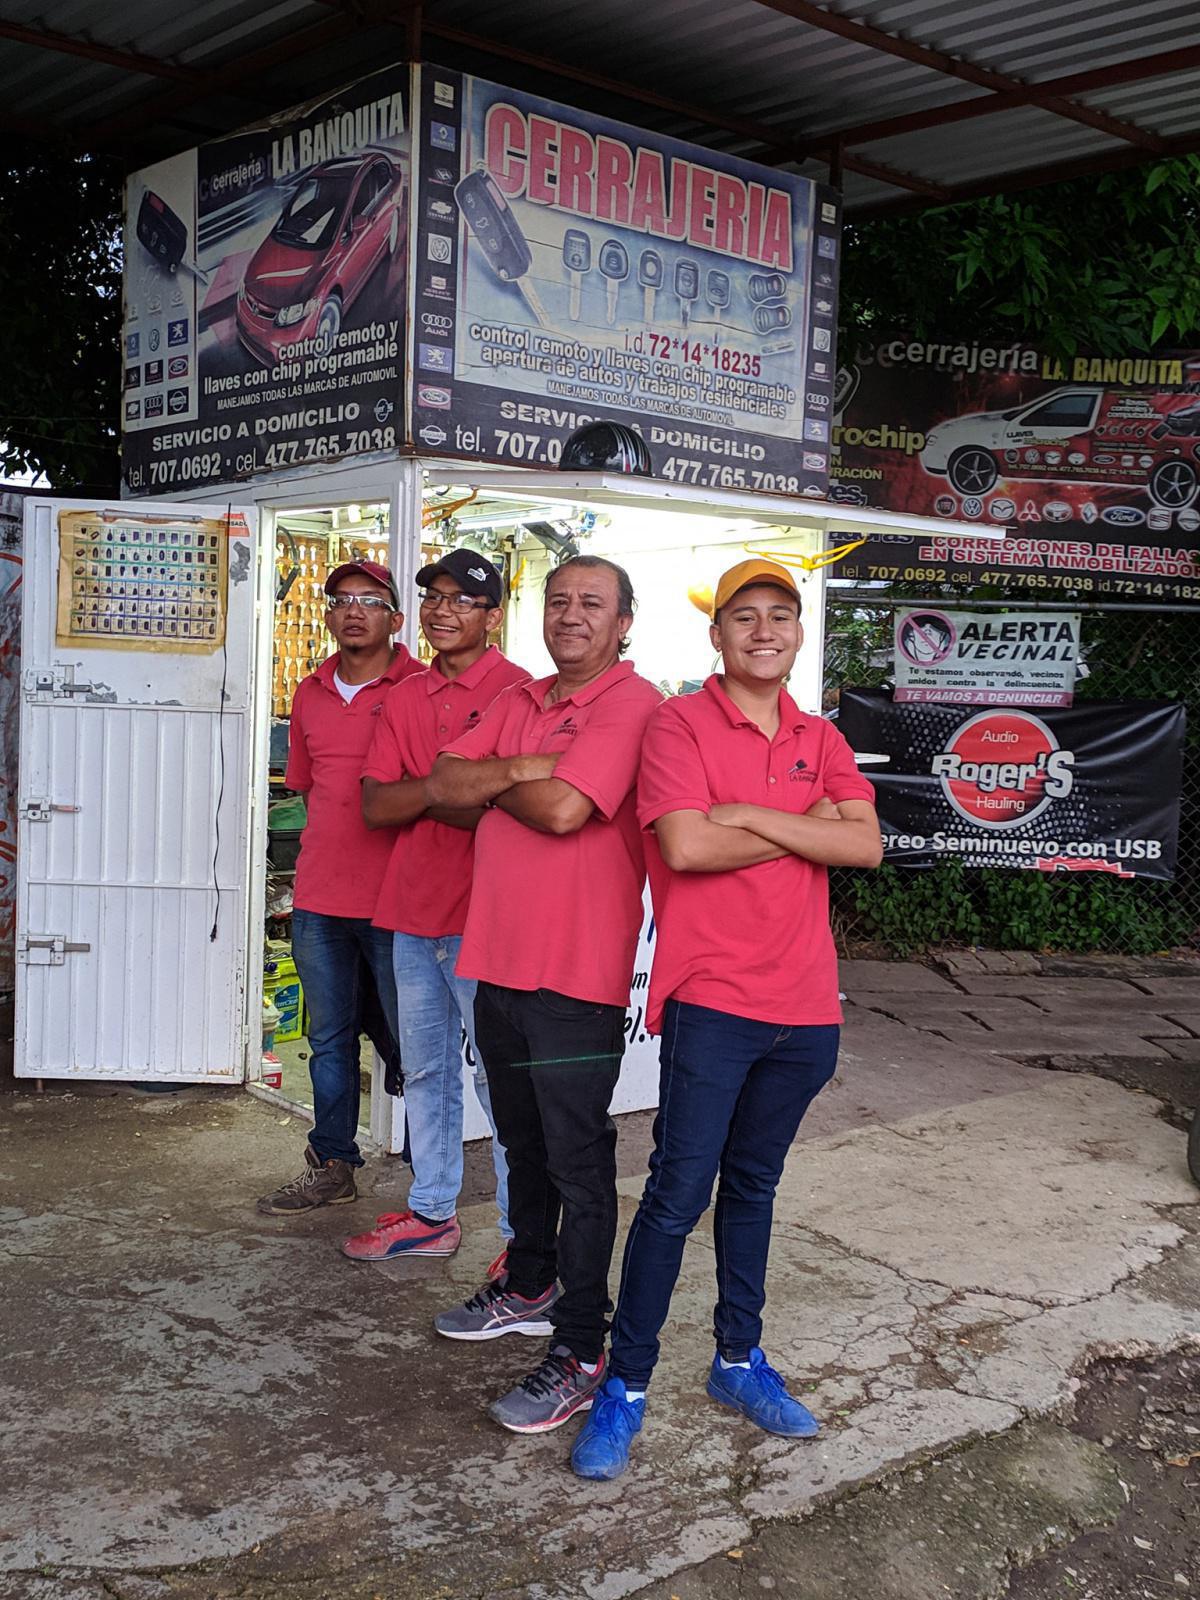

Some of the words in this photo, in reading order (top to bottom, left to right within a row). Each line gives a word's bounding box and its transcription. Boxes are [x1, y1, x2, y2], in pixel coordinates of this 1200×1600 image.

[272, 135, 295, 179] LA
[299, 91, 405, 166] BANQUITA
[486, 102, 794, 274] CERRAJERIA
[278, 332, 331, 361] control
[332, 327, 386, 348] remoto
[389, 318, 398, 341] y
[888, 341, 1038, 374] cerrajería
[204, 373, 241, 395] llaves
[244, 368, 269, 388] con
[272, 358, 301, 385] chip
[304, 340, 398, 376] programable
[470, 324, 530, 350] control
[534, 337, 588, 361] remoto
[592, 348, 603, 368] y
[606, 348, 650, 374] llaves
[653, 363, 680, 381] con
[683, 366, 712, 390] chip
[715, 375, 796, 404] programable
[482, 345, 551, 373] apertura
[556, 358, 575, 378] de
[579, 365, 622, 386] autos
[625, 374, 636, 393] y
[639, 373, 697, 401] trabajos
[700, 388, 786, 419] residenciales
[1073, 357, 1183, 386] BANQUITA
[217, 392, 261, 410] MANEJAMOS
[262, 388, 286, 404] TODAS
[287, 385, 303, 398] LAS
[304, 379, 338, 396] MARCAS
[338, 375, 350, 388] DE
[351, 366, 398, 386] AUTOMOVIL
[547, 380, 600, 401] MANEJAMOS
[601, 389, 629, 406] TODAS
[630, 396, 646, 409] LAS
[647, 399, 680, 416] MARCAS
[681, 404, 692, 418] DE
[693, 407, 735, 425] AUTOMOVIL
[152, 425, 232, 452] SERVICIO
[236, 421, 250, 439] A
[255, 402, 361, 436] DOMICILIO
[500, 400, 601, 430] SERVIC
[650, 426, 766, 462] DOMICILIO
[128, 465, 146, 488] tel.
[150, 452, 221, 485] 707.0692
[265, 426, 396, 468] 477.765.7038
[455, 423, 486, 453] tel.
[494, 429, 563, 463] 707.0
[662, 456, 799, 493] 477.765.7038
[918, 546, 950, 562] EN
[952, 549, 1046, 568] SISTEMA
[931, 536, 1097, 558] CORRECCIONES
[1095, 543, 1126, 560] DE
[842, 566, 864, 579] tel.
[868, 566, 947, 583] 707.0692
[951, 568, 977, 584] cel.
[979, 572, 1094, 592] 477.765.7038
[959, 621, 1075, 644] ALERTA
[956, 643, 1076, 662] VECINAL
[908, 667, 920, 675] Te
[925, 668, 964, 677] estamos
[969, 670, 1025, 680] observando,
[1030, 670, 1065, 679] vecinos
[908, 678, 937, 687] unidos
[947, 679, 977, 687] contra
[986, 679, 996, 687] la
[1004, 679, 1065, 689] delincuencia.
[905, 690, 923, 701] TE
[924, 690, 972, 702] VAMOS
[975, 692, 985, 703] A
[987, 693, 1064, 705] DENUNCIAR
[980, 730, 1020, 744] Audio
[931, 750, 1075, 799] Roger'S
[976, 795, 1026, 812] Hauling
[881, 834, 926, 850] ereo
[932, 832, 1060, 856] Seminuevo
[1065, 838, 1108, 858] con
[1115, 838, 1162, 860] USB
